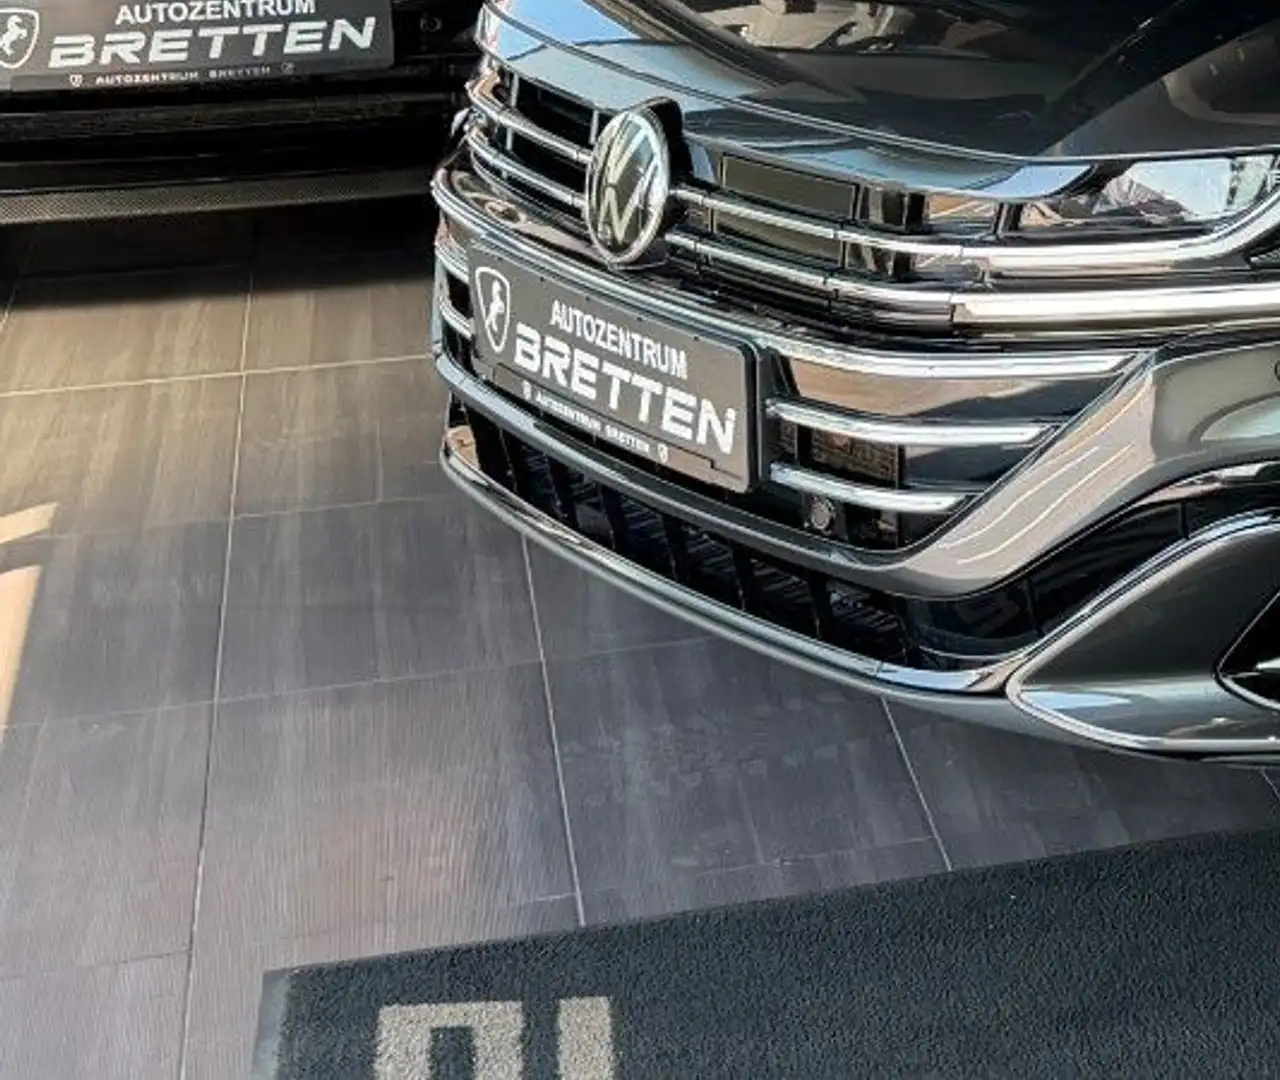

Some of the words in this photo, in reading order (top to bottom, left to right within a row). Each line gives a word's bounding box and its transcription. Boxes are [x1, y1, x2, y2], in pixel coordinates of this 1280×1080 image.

[48, 16, 376, 68] BRETTEN
[550, 299, 688, 380] AUTOZENTRUM
[514, 321, 736, 455] BRETTEN
